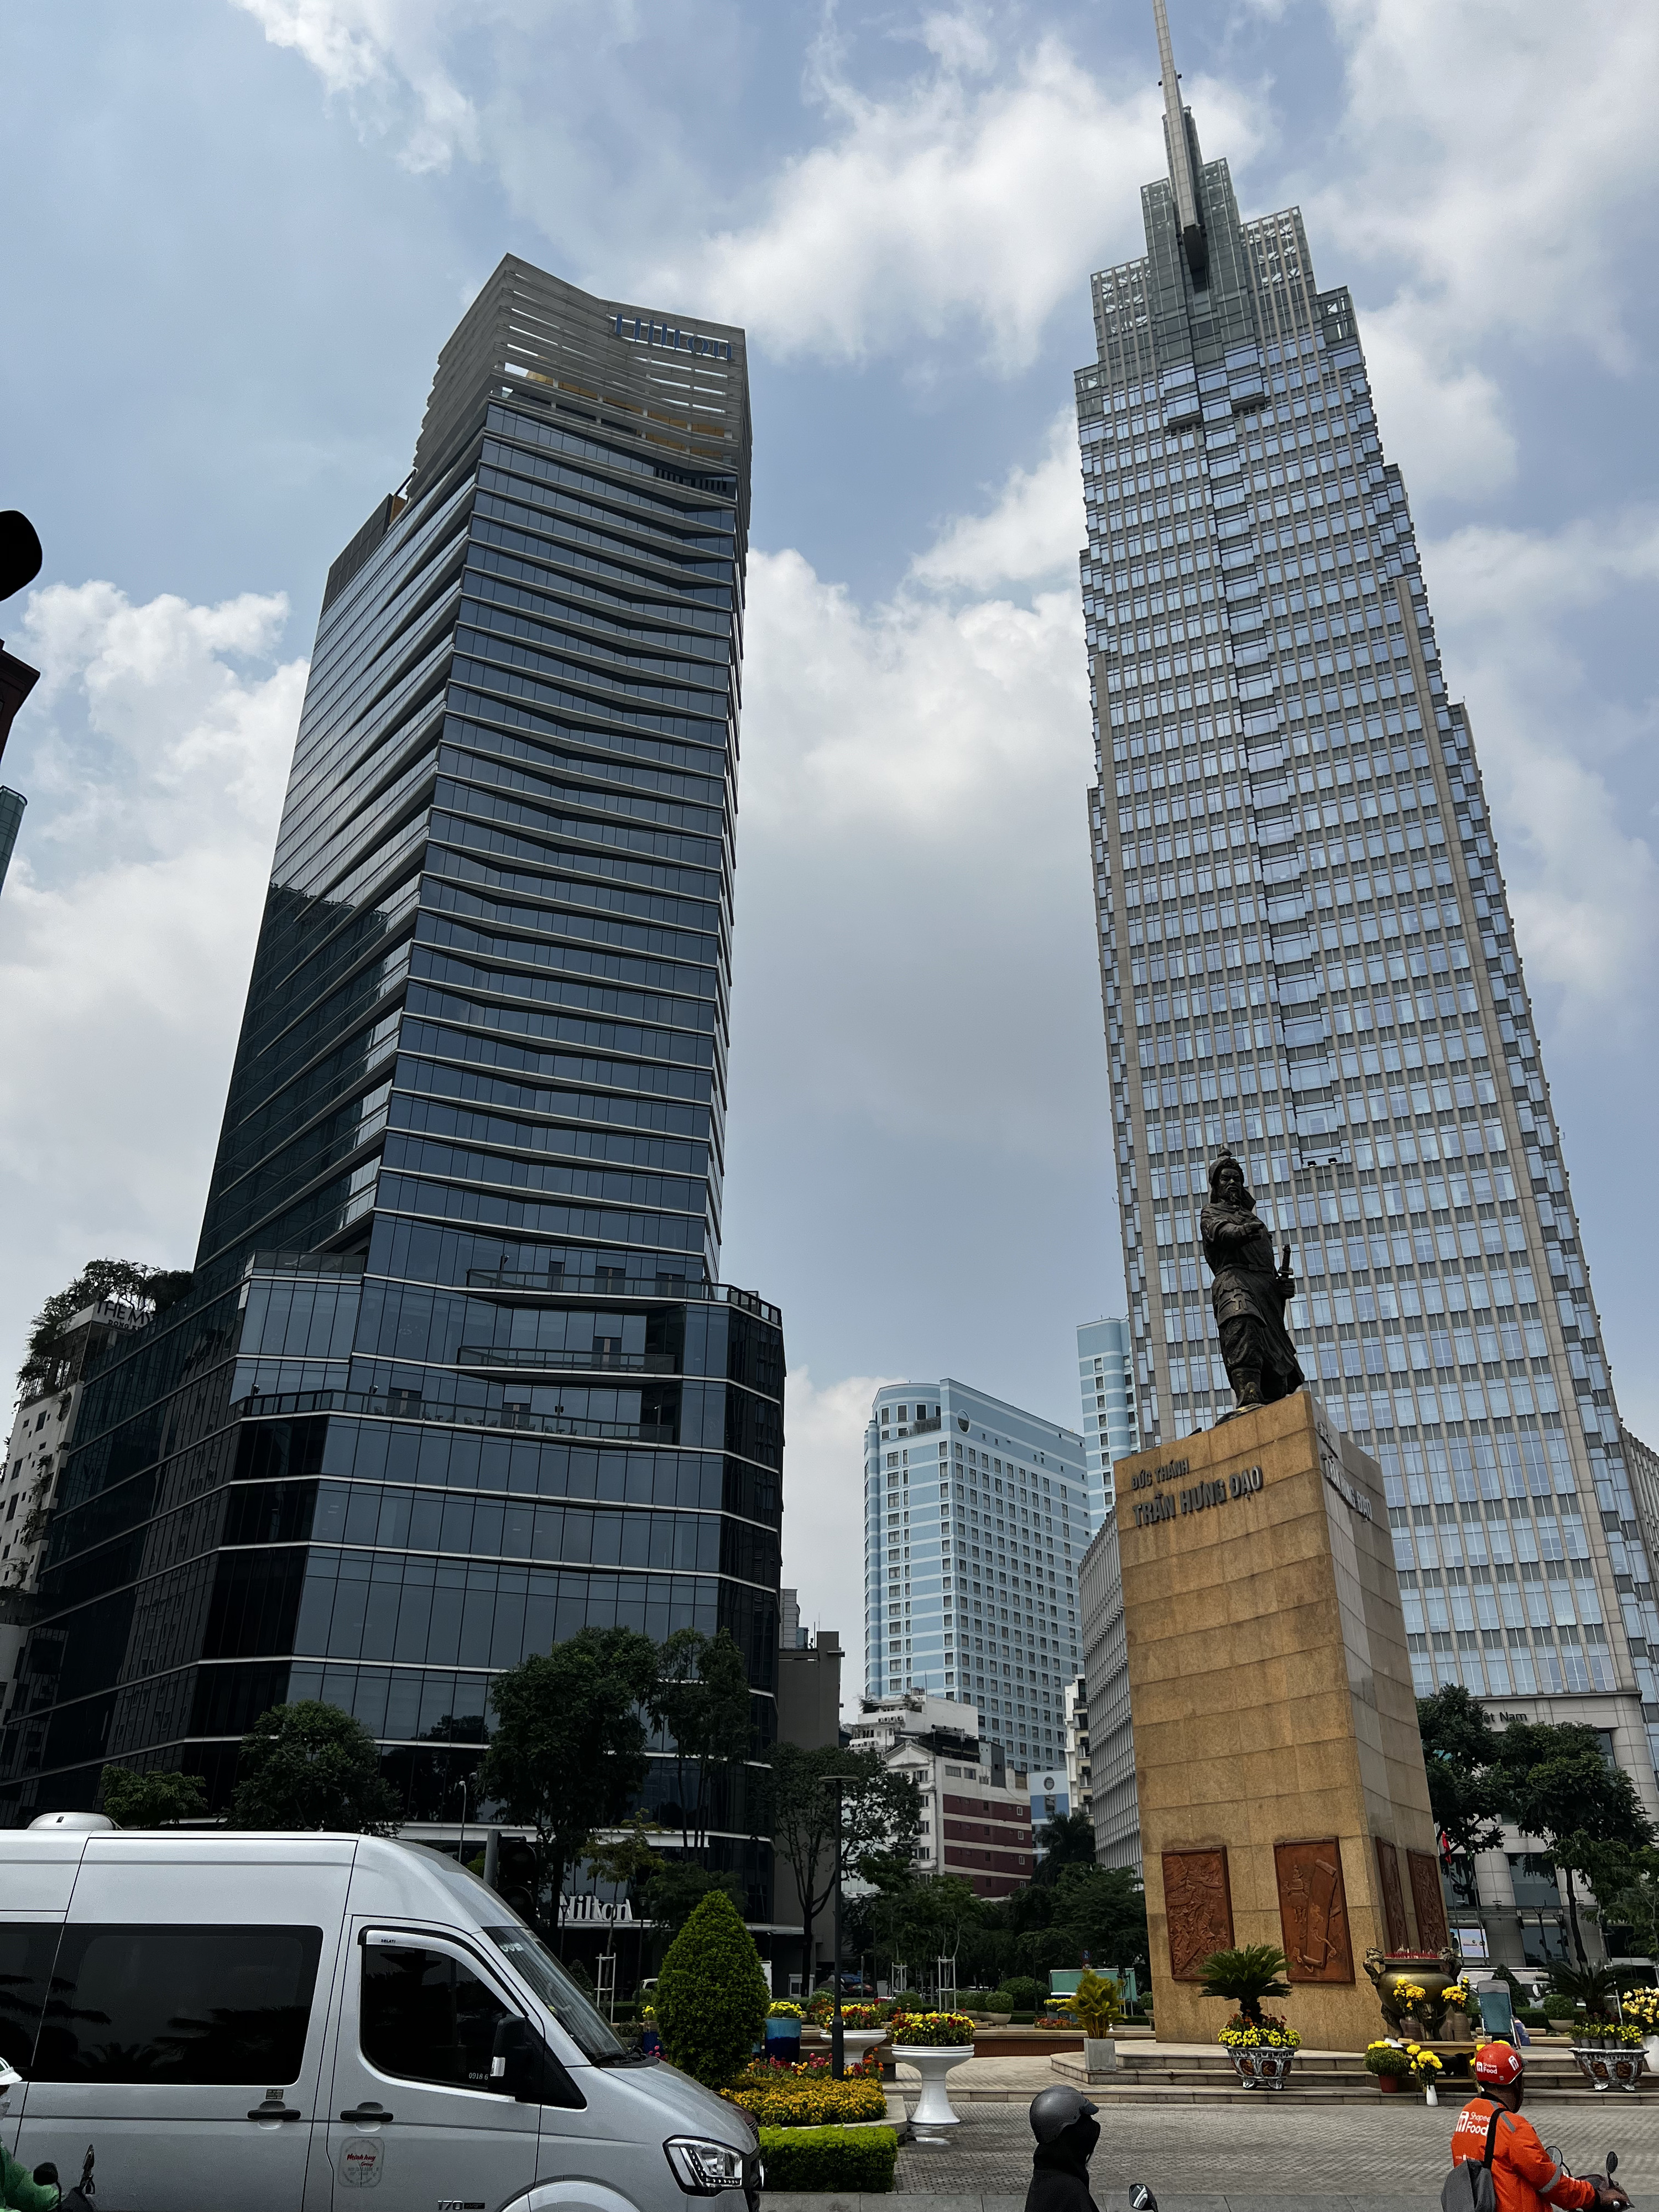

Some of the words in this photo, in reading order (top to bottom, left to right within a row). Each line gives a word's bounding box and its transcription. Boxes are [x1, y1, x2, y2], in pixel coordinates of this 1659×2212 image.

[615, 314, 733, 360] Hilton
[1131, 1469, 1152, 1490] ĐỨC
[1154, 1457, 1190, 1483] THÁNH
[1133, 1491, 1176, 1527] TRẦN
[1180, 1478, 1227, 1514] HƯNG
[1229, 1465, 1264, 1502] ĐẠO
[1499, 1712, 1527, 1722] Nam
[558, 1896, 631, 1921] Hilton
[1470, 2111, 1491, 2123] Shopee
[1465, 2121, 1489, 2137] Food
[437, 2200, 463, 2210] 170
